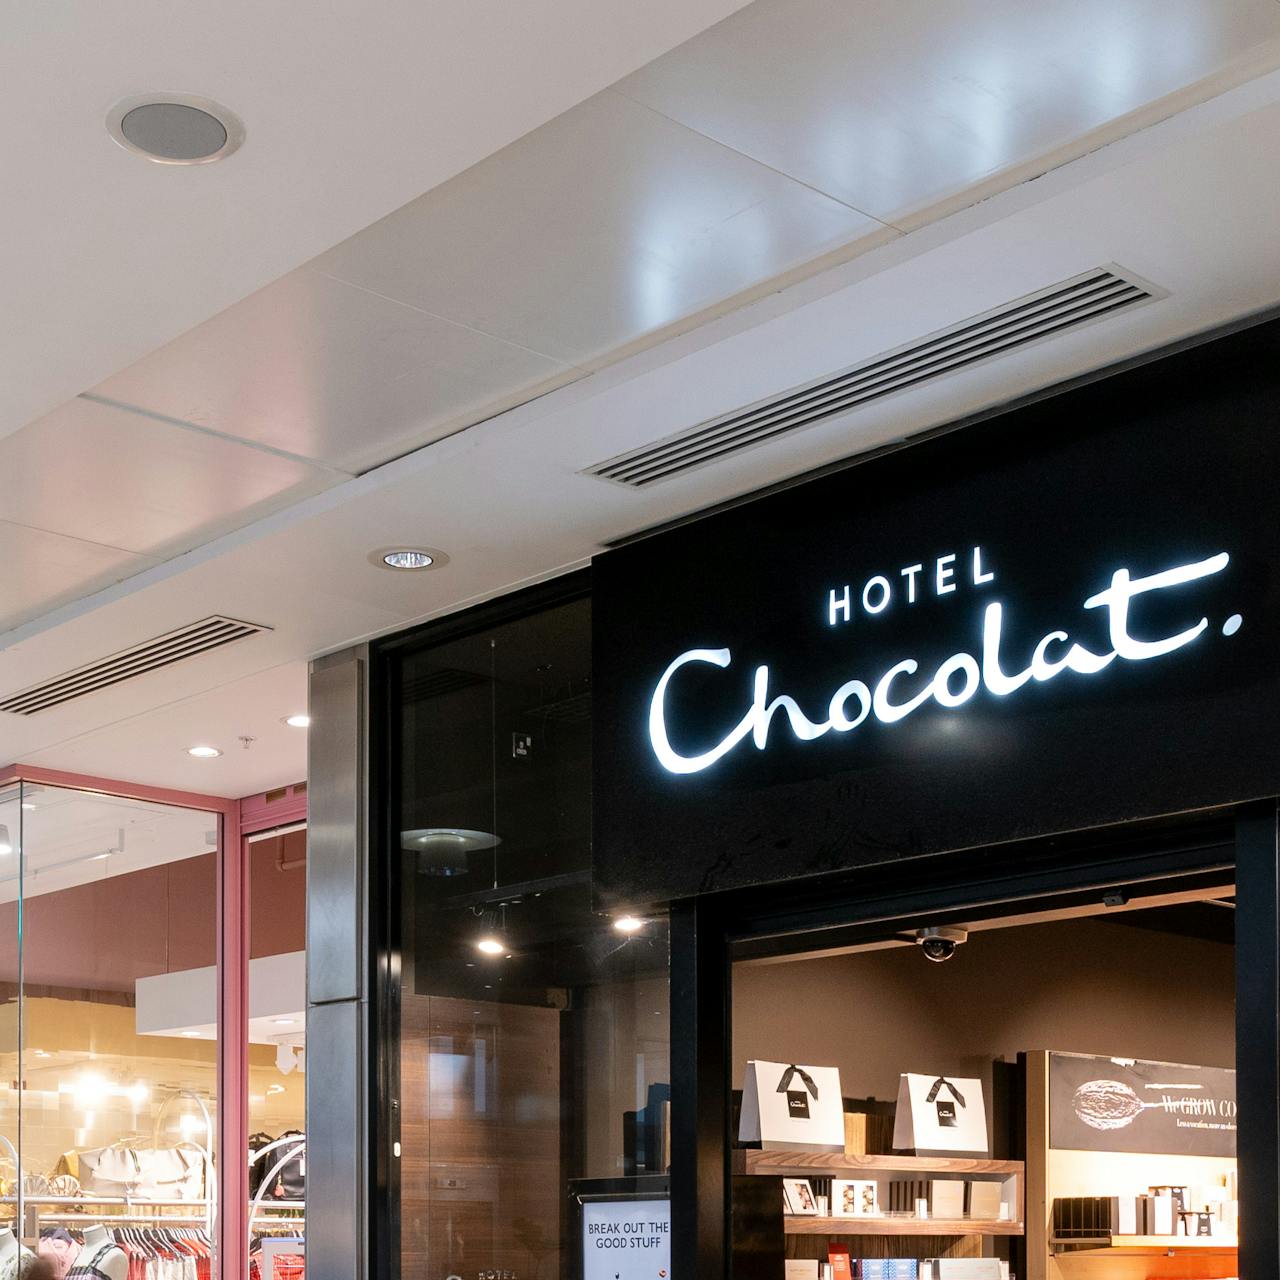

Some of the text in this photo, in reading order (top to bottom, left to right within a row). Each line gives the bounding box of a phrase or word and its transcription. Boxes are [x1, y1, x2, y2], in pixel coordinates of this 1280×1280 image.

[829, 546, 995, 626] HOTEL
[588, 1221, 669, 1234] BREAK OUT THE
[596, 1236, 661, 1249] GOOD STUFF
